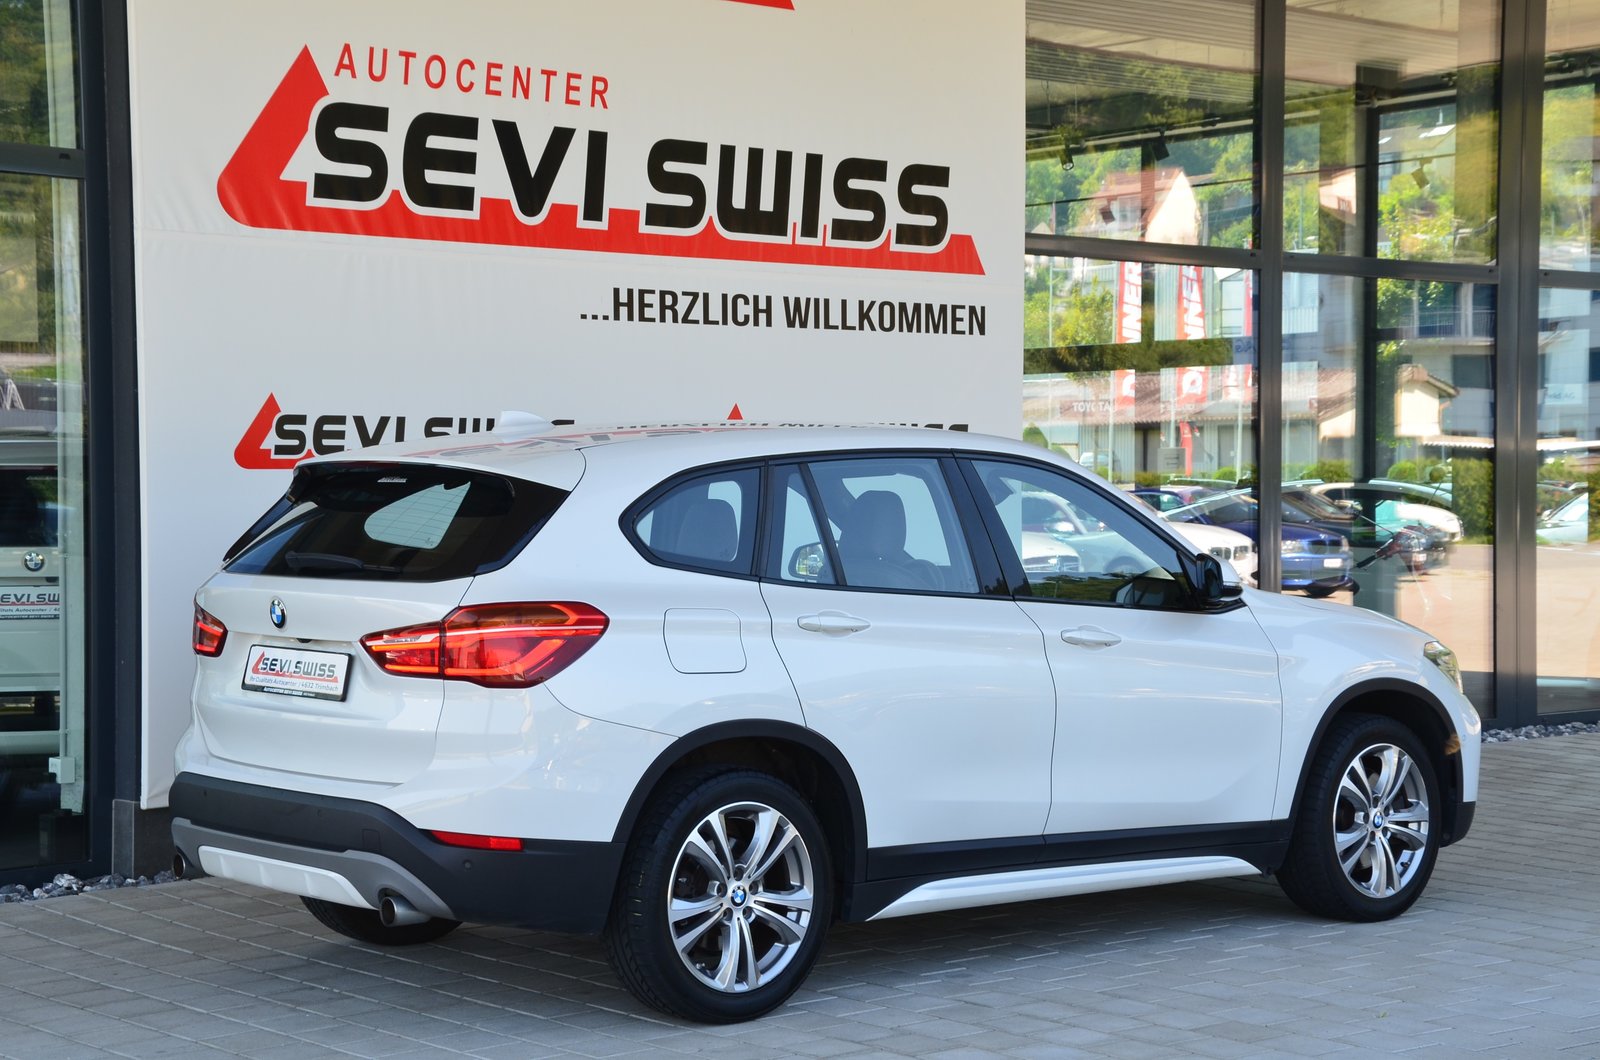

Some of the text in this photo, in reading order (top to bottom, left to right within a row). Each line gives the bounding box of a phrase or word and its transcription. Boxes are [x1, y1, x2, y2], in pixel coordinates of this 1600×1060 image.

[335, 43, 609, 109] AUTOCENTER
[313, 101, 950, 247] SEVI SWISS
[783, 296, 986, 336] WILLKOMMEN
[1121, 262, 1142, 398] DNNER
[273, 414, 406, 456] SEVI
[260, 657, 336, 678] SEVI SWISS
